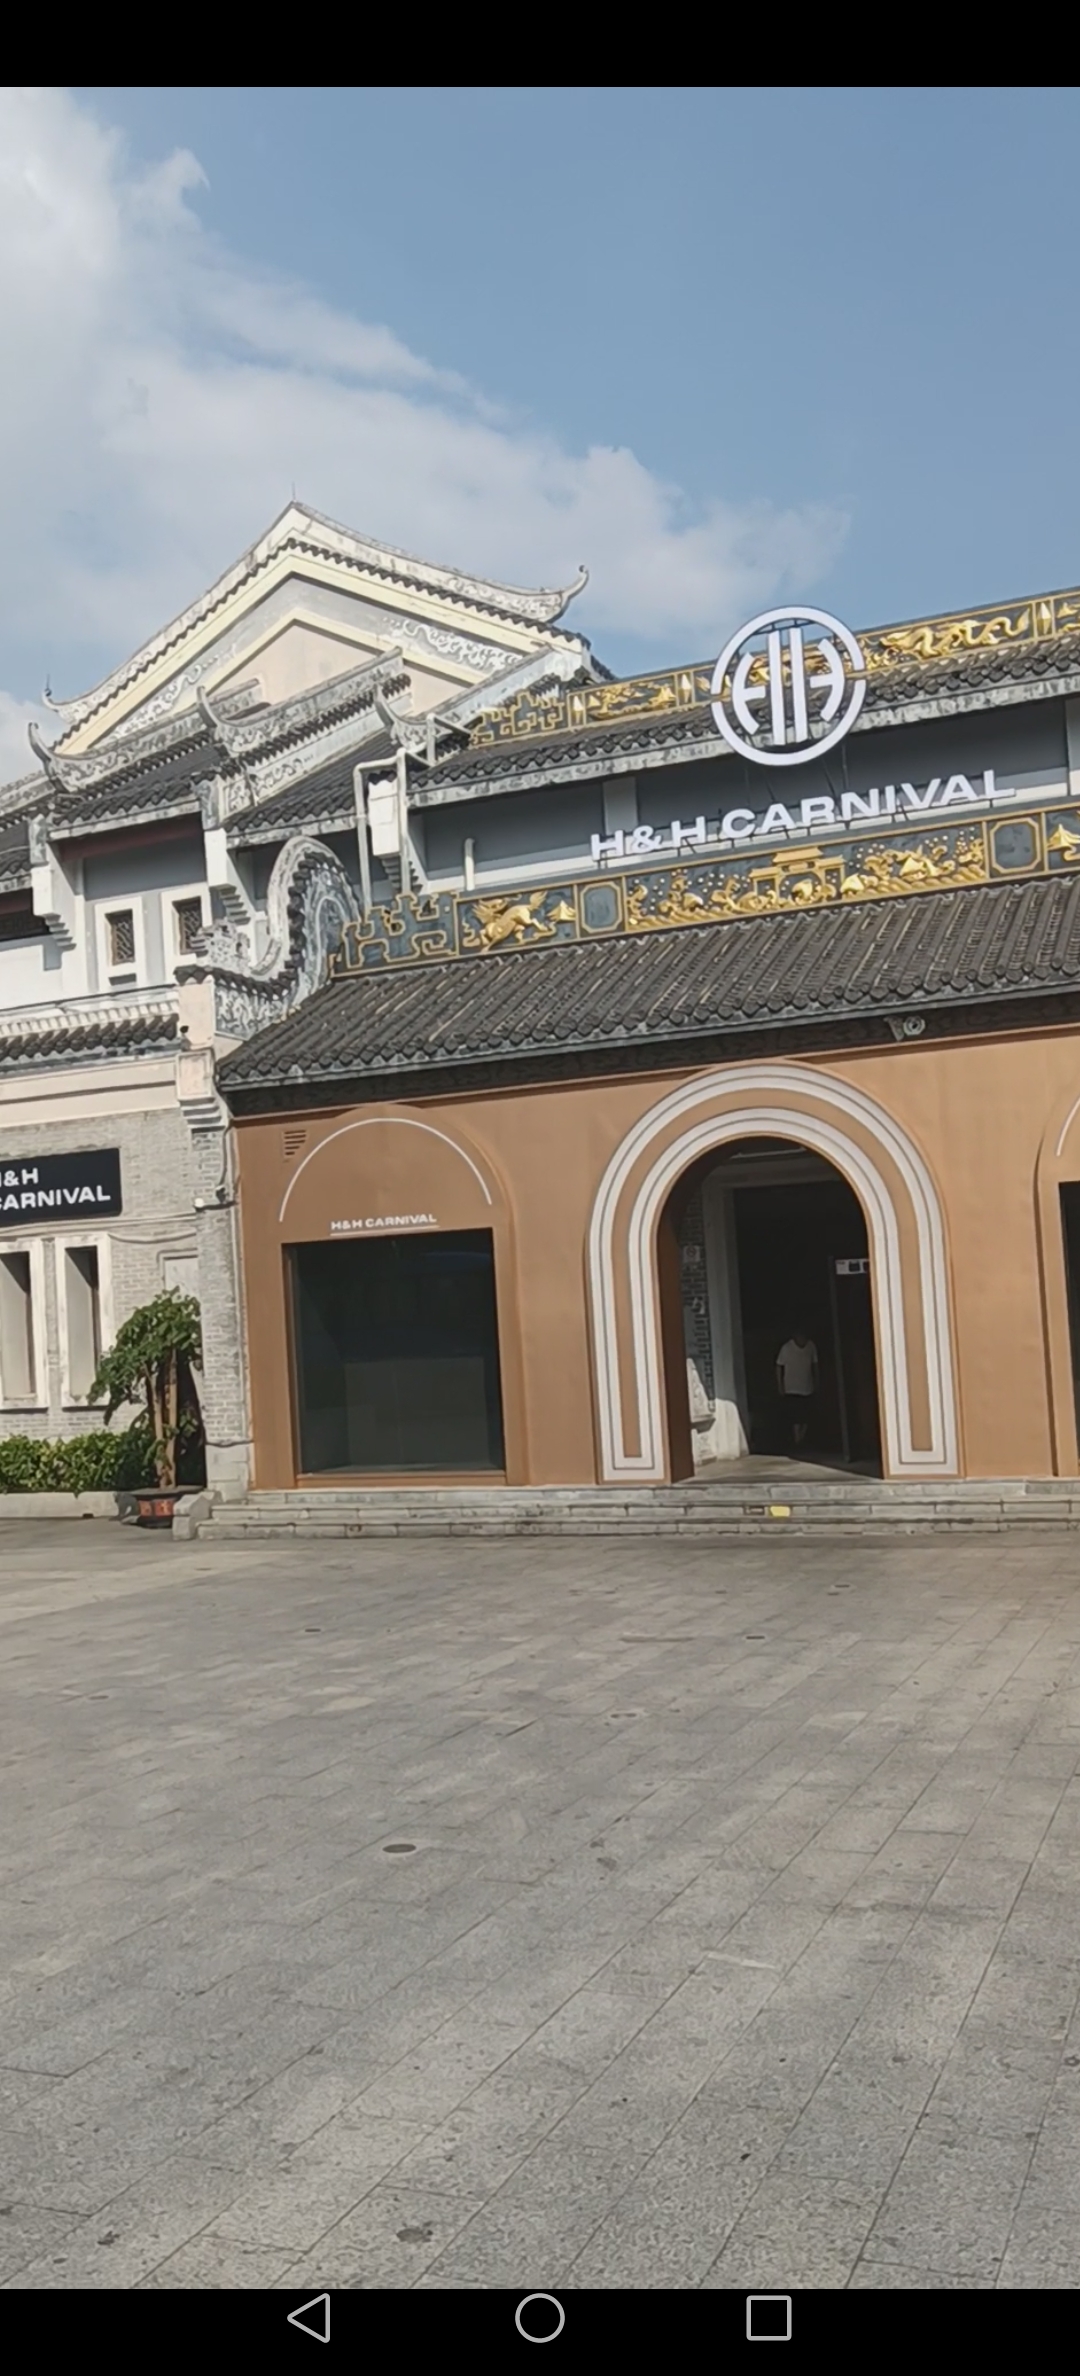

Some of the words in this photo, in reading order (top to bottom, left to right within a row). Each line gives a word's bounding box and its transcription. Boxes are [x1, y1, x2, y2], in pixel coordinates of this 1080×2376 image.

[721, 769, 1017, 840] CARNIVAL
[0, 1167, 39, 1188] &H
[0, 1184, 112, 1211] ARNIVAL
[364, 1213, 438, 1228] CARNIVAL
